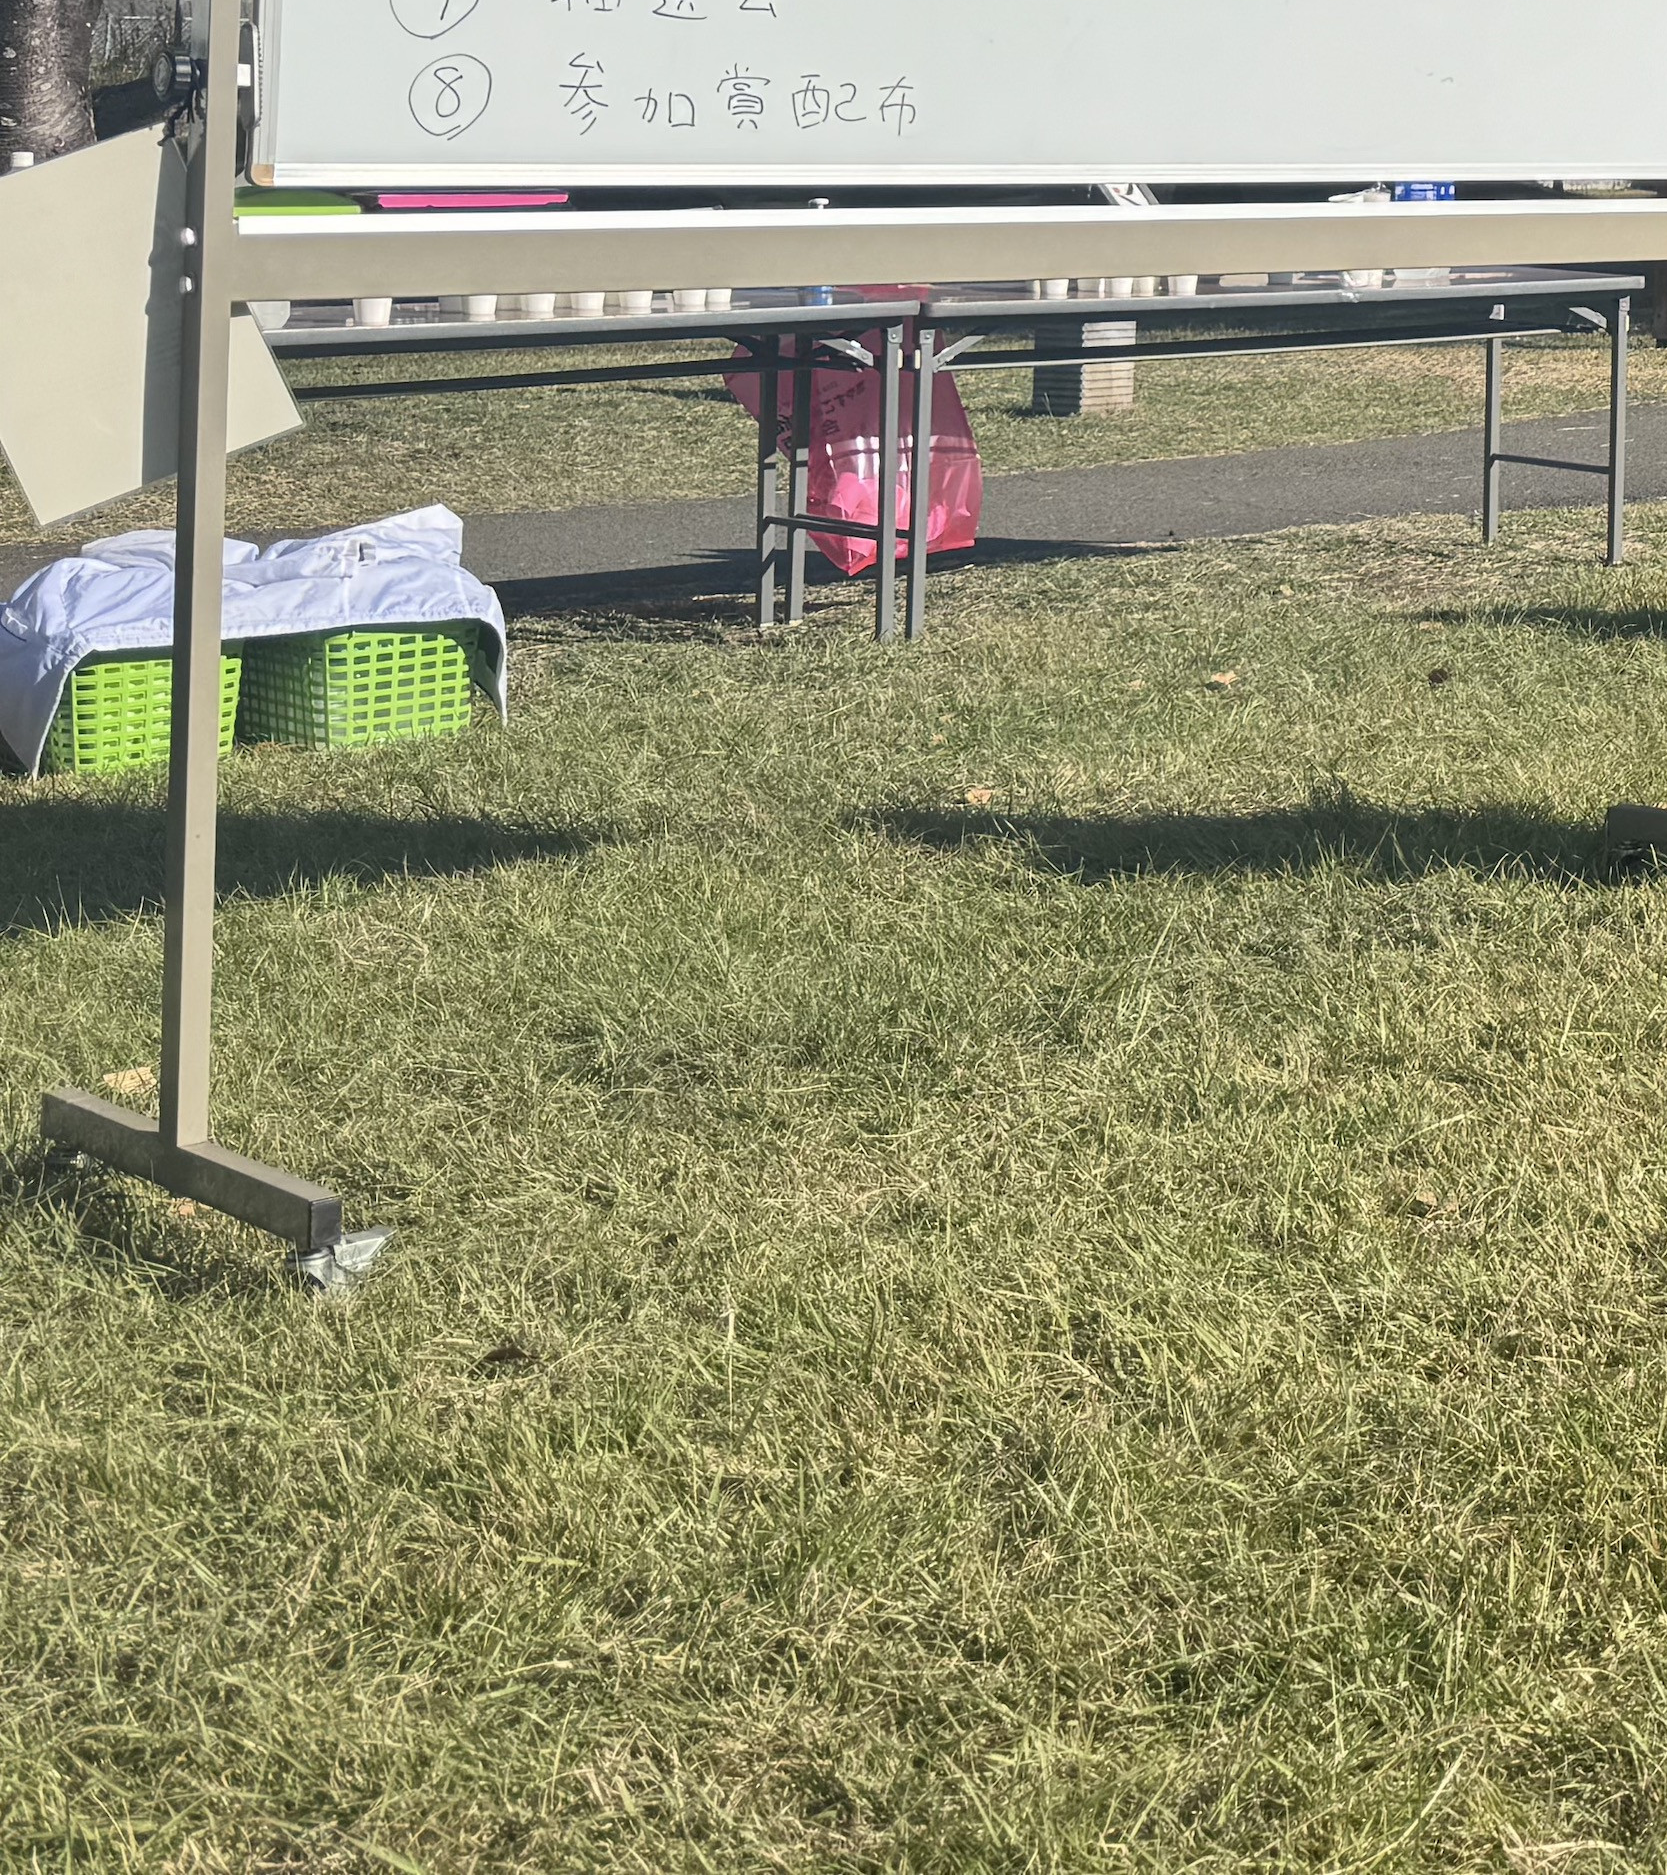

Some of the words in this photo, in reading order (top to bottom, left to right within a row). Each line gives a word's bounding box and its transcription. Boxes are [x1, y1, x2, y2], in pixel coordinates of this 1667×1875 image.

[559, 52, 918, 137] 参加賞配布
